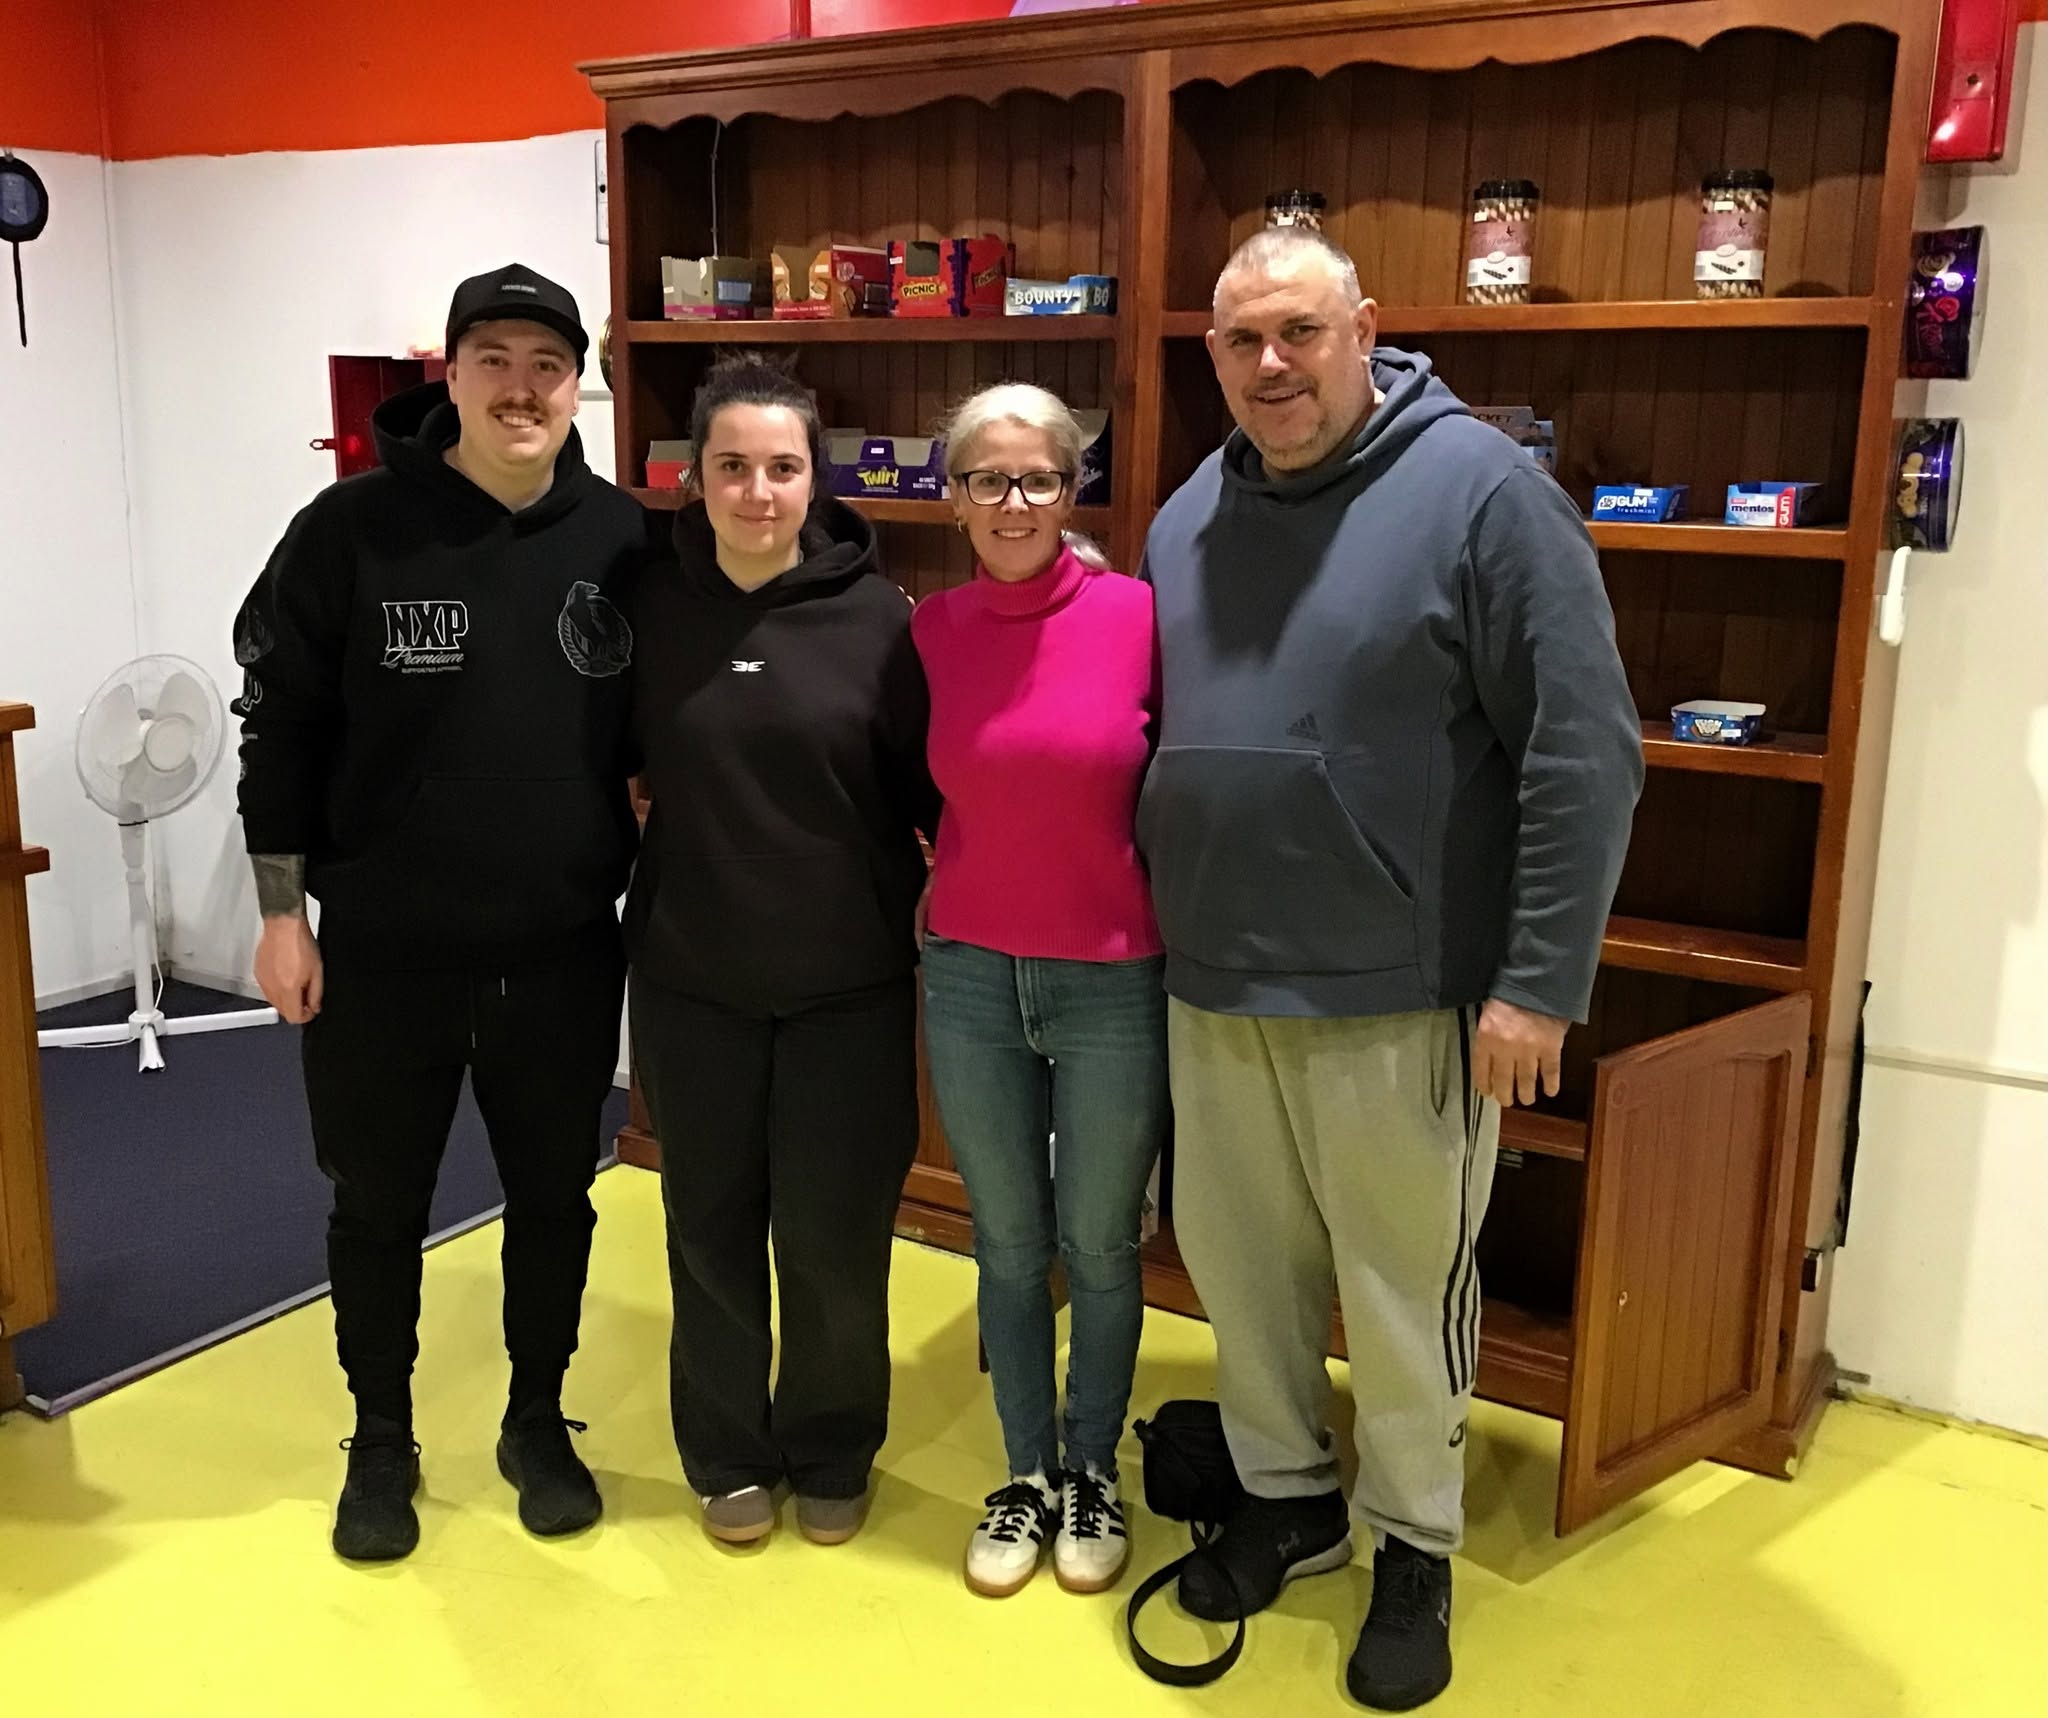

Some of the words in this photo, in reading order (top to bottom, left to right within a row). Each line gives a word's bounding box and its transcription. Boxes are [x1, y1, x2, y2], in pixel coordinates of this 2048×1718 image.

[903, 284, 936, 297] PICNIC
[1014, 288, 1073, 305] BOUNTY
[1616, 495, 1647, 508] GUM
[1731, 504, 1774, 513] mentos
[382, 600, 468, 651] NXP
[380, 645, 464, 669] Premium
